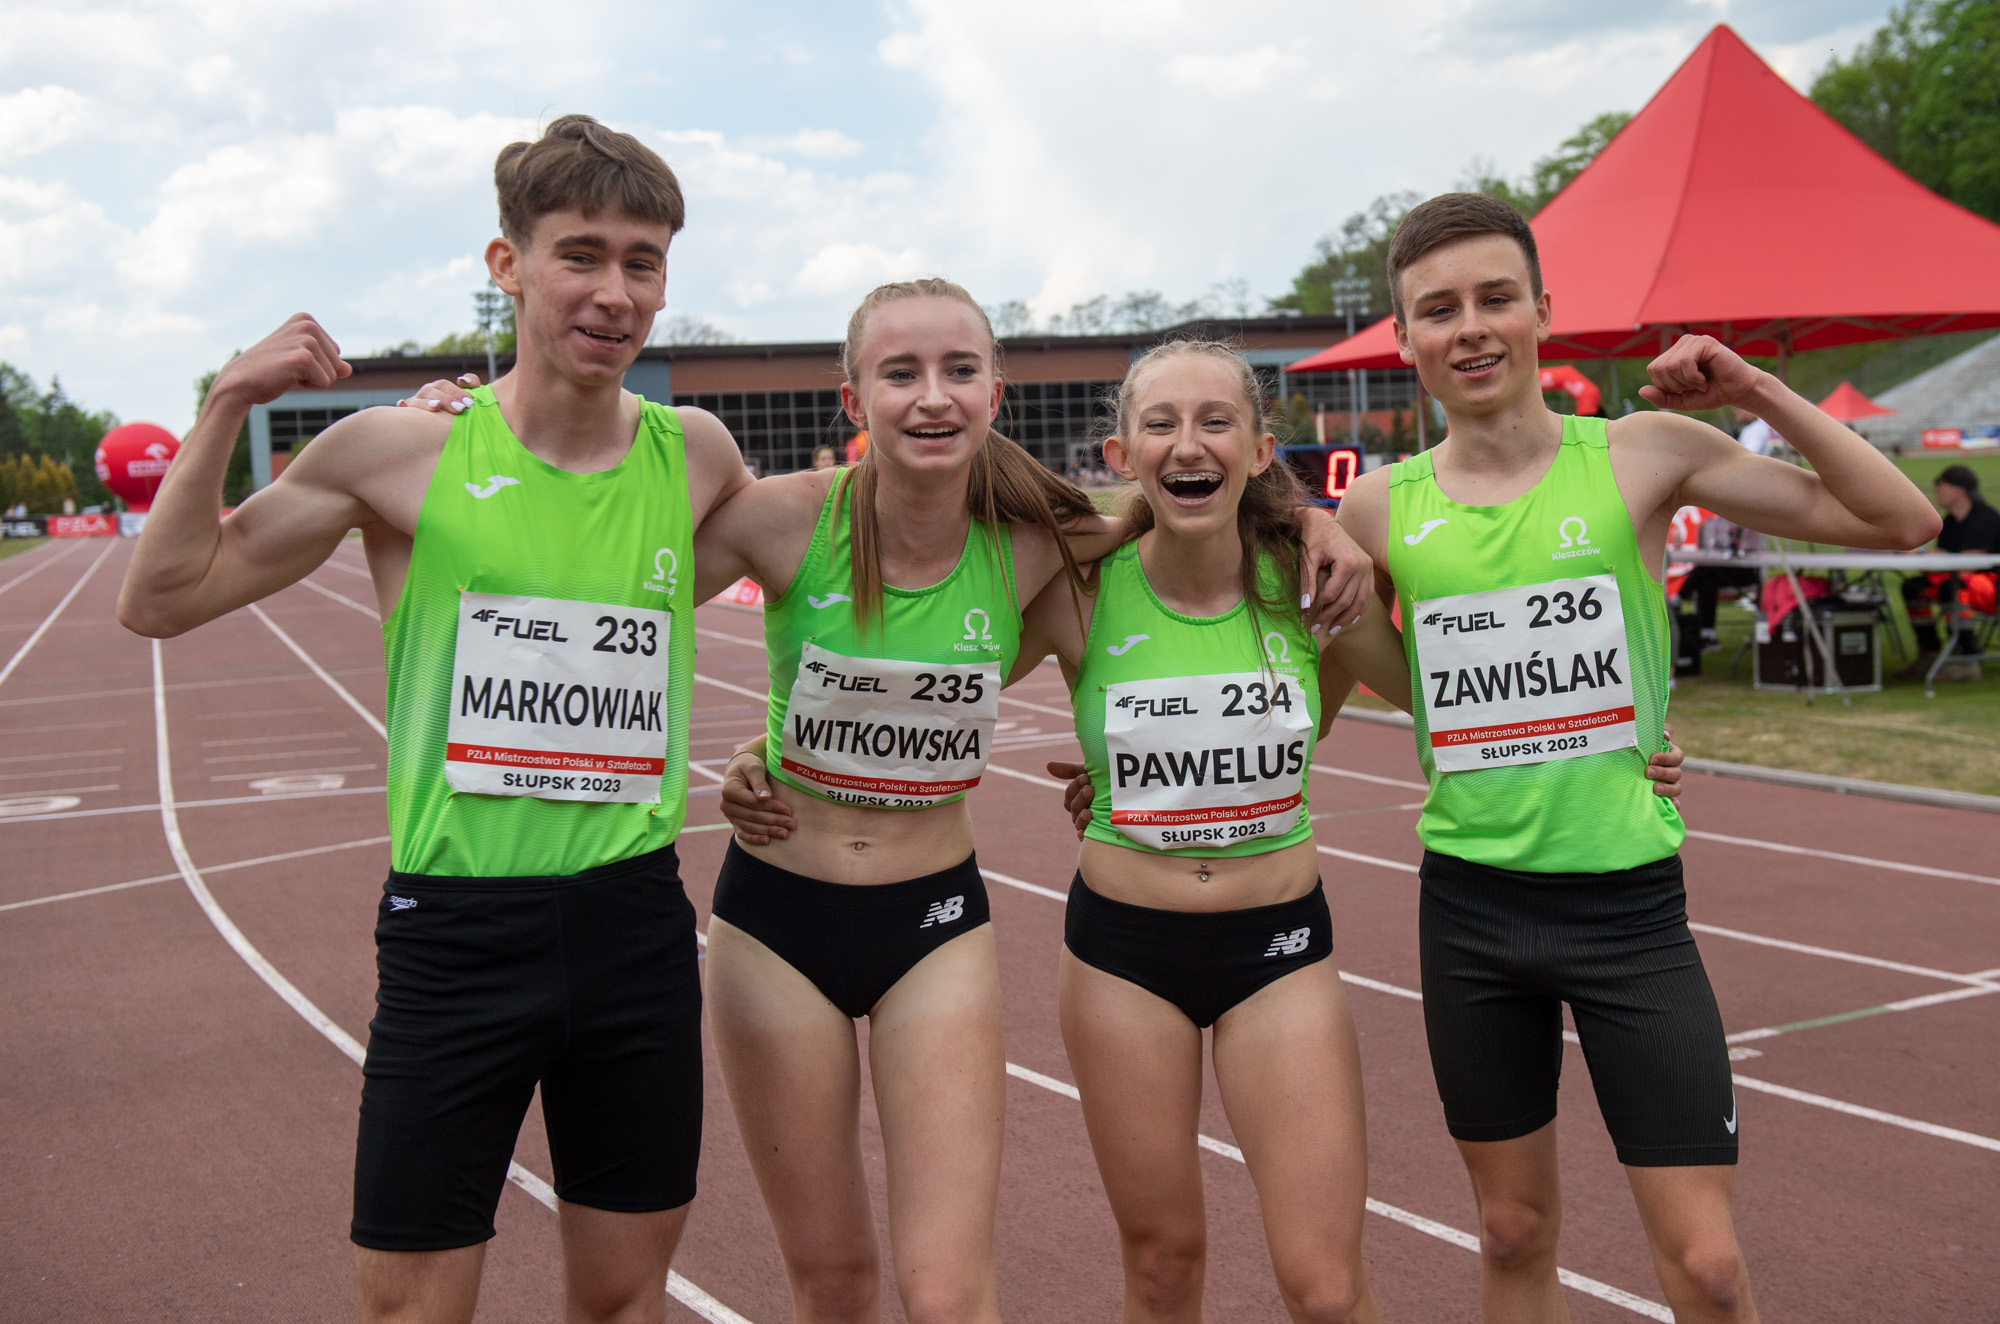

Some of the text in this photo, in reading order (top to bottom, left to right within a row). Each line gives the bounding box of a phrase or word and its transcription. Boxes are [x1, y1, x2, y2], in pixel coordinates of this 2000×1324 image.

[1327, 449, 1357, 498] 0
[1552, 546, 1600, 560] Kleszczów
[1526, 587, 1602, 628] 236
[494, 616, 568, 643] FUEL
[593, 615, 657, 656] 233
[1442, 611, 1505, 635] FUEL
[822, 671, 888, 693] FUEL
[910, 673, 984, 704] 235
[1430, 648, 1622, 708] ZAWIŚLAK
[461, 674, 663, 732] MARKOWIAK
[1134, 697, 1199, 718] FUEL
[1221, 682, 1292, 717] 234
[794, 714, 980, 762] WITKOWSKA
[1447, 732, 1468, 743] PZLA
[1470, 726, 1525, 740] Mistrzostwa
[1527, 723, 1556, 733] Polski
[1568, 712, 1619, 728] Sztafetach
[466, 749, 652, 772] PZLA Mistrzostwa Polski w Sztafetach
[1481, 735, 1588, 760] SŁUPSK 2023
[1116, 740, 1305, 788] PAWELUS
[502, 772, 621, 793] SŁUPSK 2023
[796, 766, 818, 780] PZLA
[819, 773, 877, 789] Mistrzostwa
[879, 782, 907, 792] Polski
[919, 782, 967, 793] Sztafetach
[1127, 814, 1150, 822] PZLA
[1151, 812, 1209, 823] Mistrzostwa
[1210, 809, 1238, 819] Polski
[1250, 799, 1295, 816] Sztafetach
[1161, 822, 1266, 842] SŁUPSK 2023
